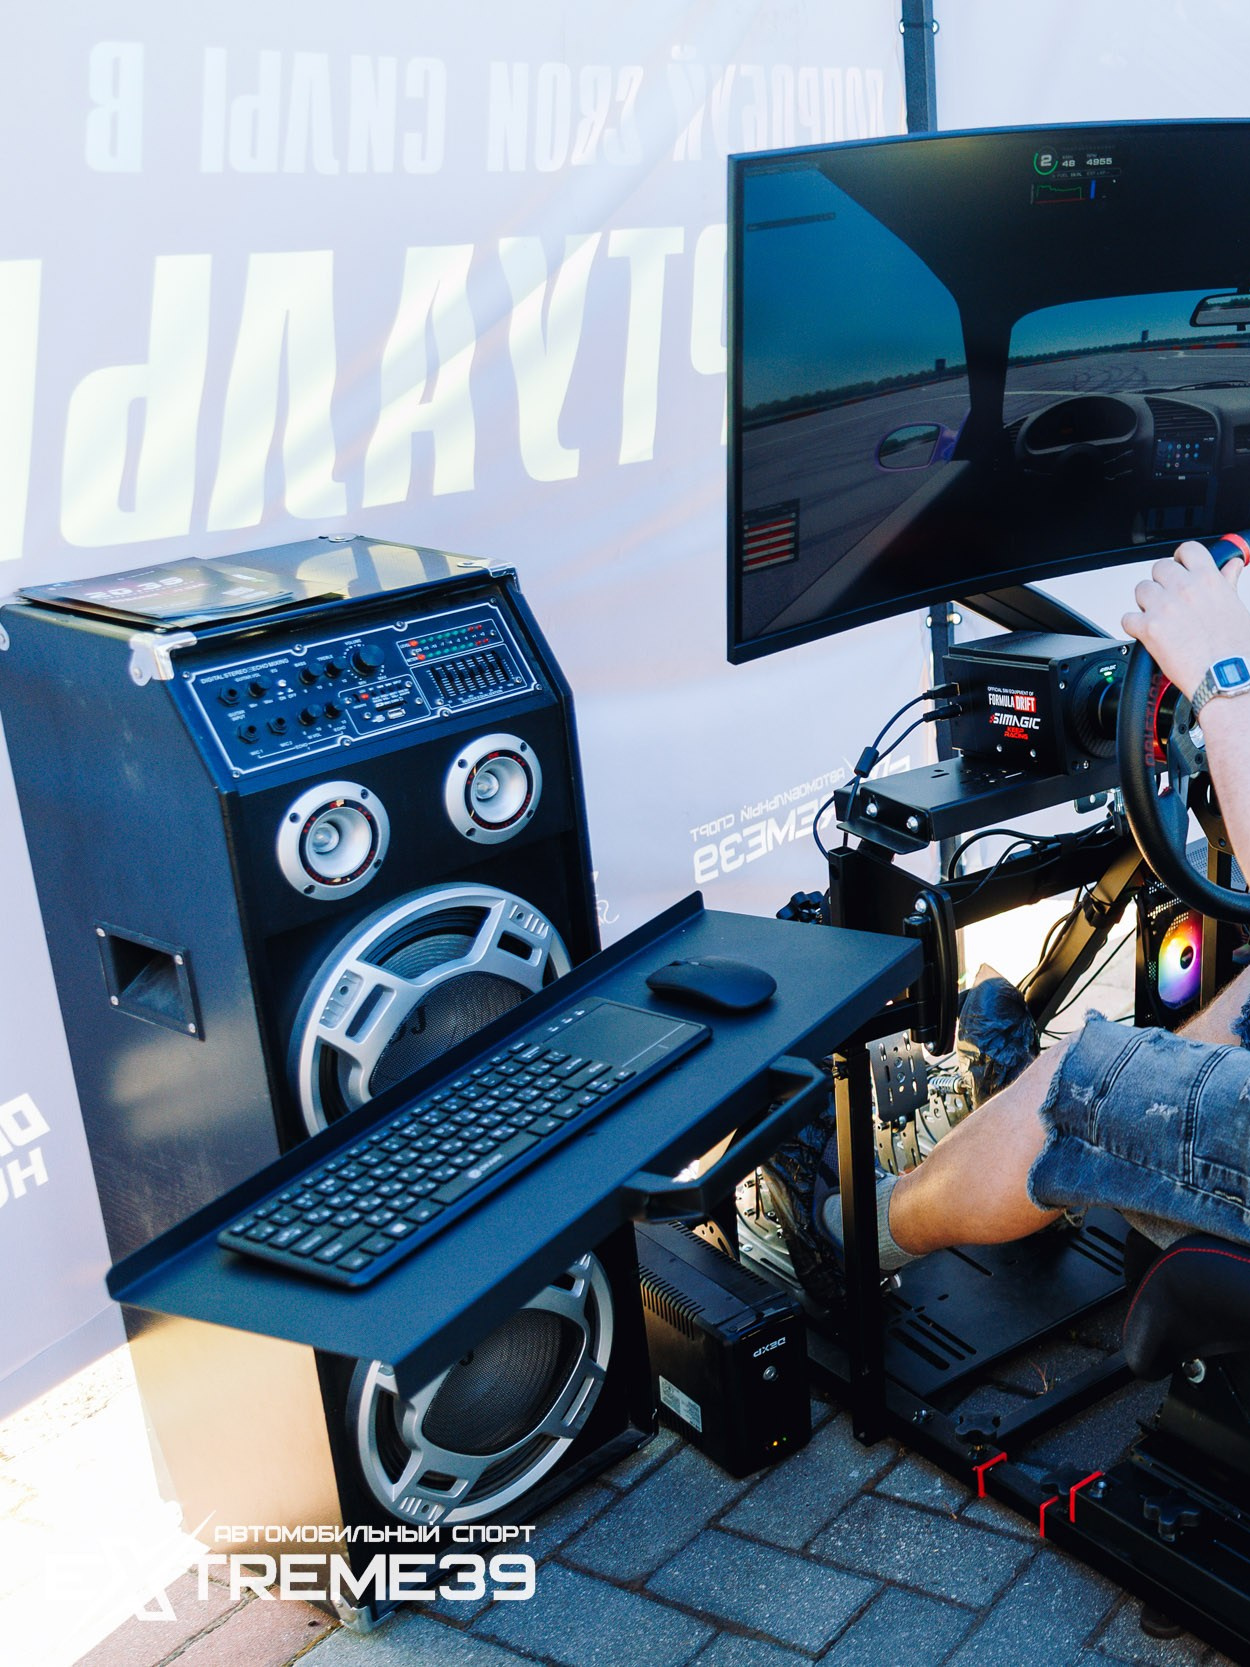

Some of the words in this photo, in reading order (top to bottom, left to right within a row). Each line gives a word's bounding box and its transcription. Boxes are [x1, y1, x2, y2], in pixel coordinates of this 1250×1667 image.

[988, 693, 1015, 708] FORMULA
[1015, 696, 1036, 712] DRIFT
[993, 713, 1041, 729] SIMAGIC
[1004, 731, 1028, 739] RACING
